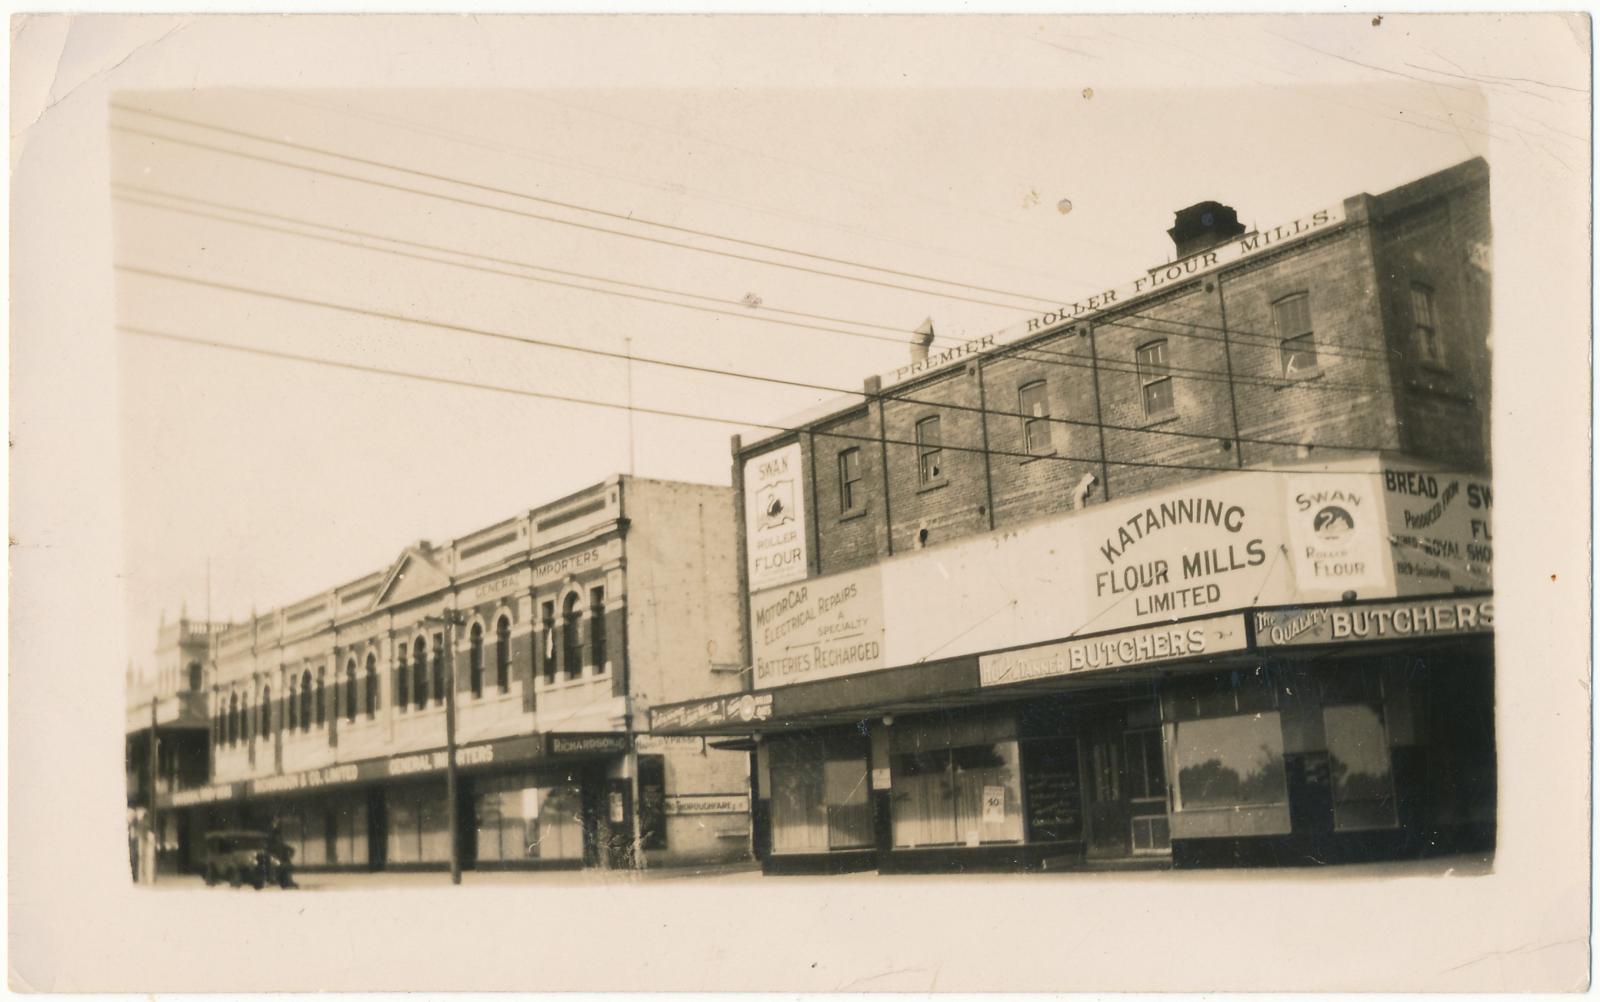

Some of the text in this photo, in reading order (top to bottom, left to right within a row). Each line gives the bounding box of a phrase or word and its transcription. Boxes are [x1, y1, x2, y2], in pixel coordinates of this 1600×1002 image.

[1026, 289, 1119, 344] ROLLER
[1133, 252, 1220, 293] FLOUR
[758, 457, 790, 479] SWAN
[1384, 468, 1439, 500] BREAD
[1295, 490, 1362, 512] SWAN
[1100, 498, 1246, 565] KATANNING
[474, 548, 600, 599] GENERAL IMPORTERS
[755, 549, 802, 571] FLOUR
[1095, 538, 1267, 597] FLOUR MILLS
[1313, 561, 1366, 578] FLOUR
[763, 583, 859, 647] ELECTRICAL REPAIRS
[1135, 583, 1221, 616] LIMITED
[1271, 609, 1330, 643] QUALITY
[1330, 603, 1493, 642] BUTCHERS
[757, 641, 881, 680] BATTERIES RECHARGED
[1068, 631, 1205, 672] BUTCHERS
